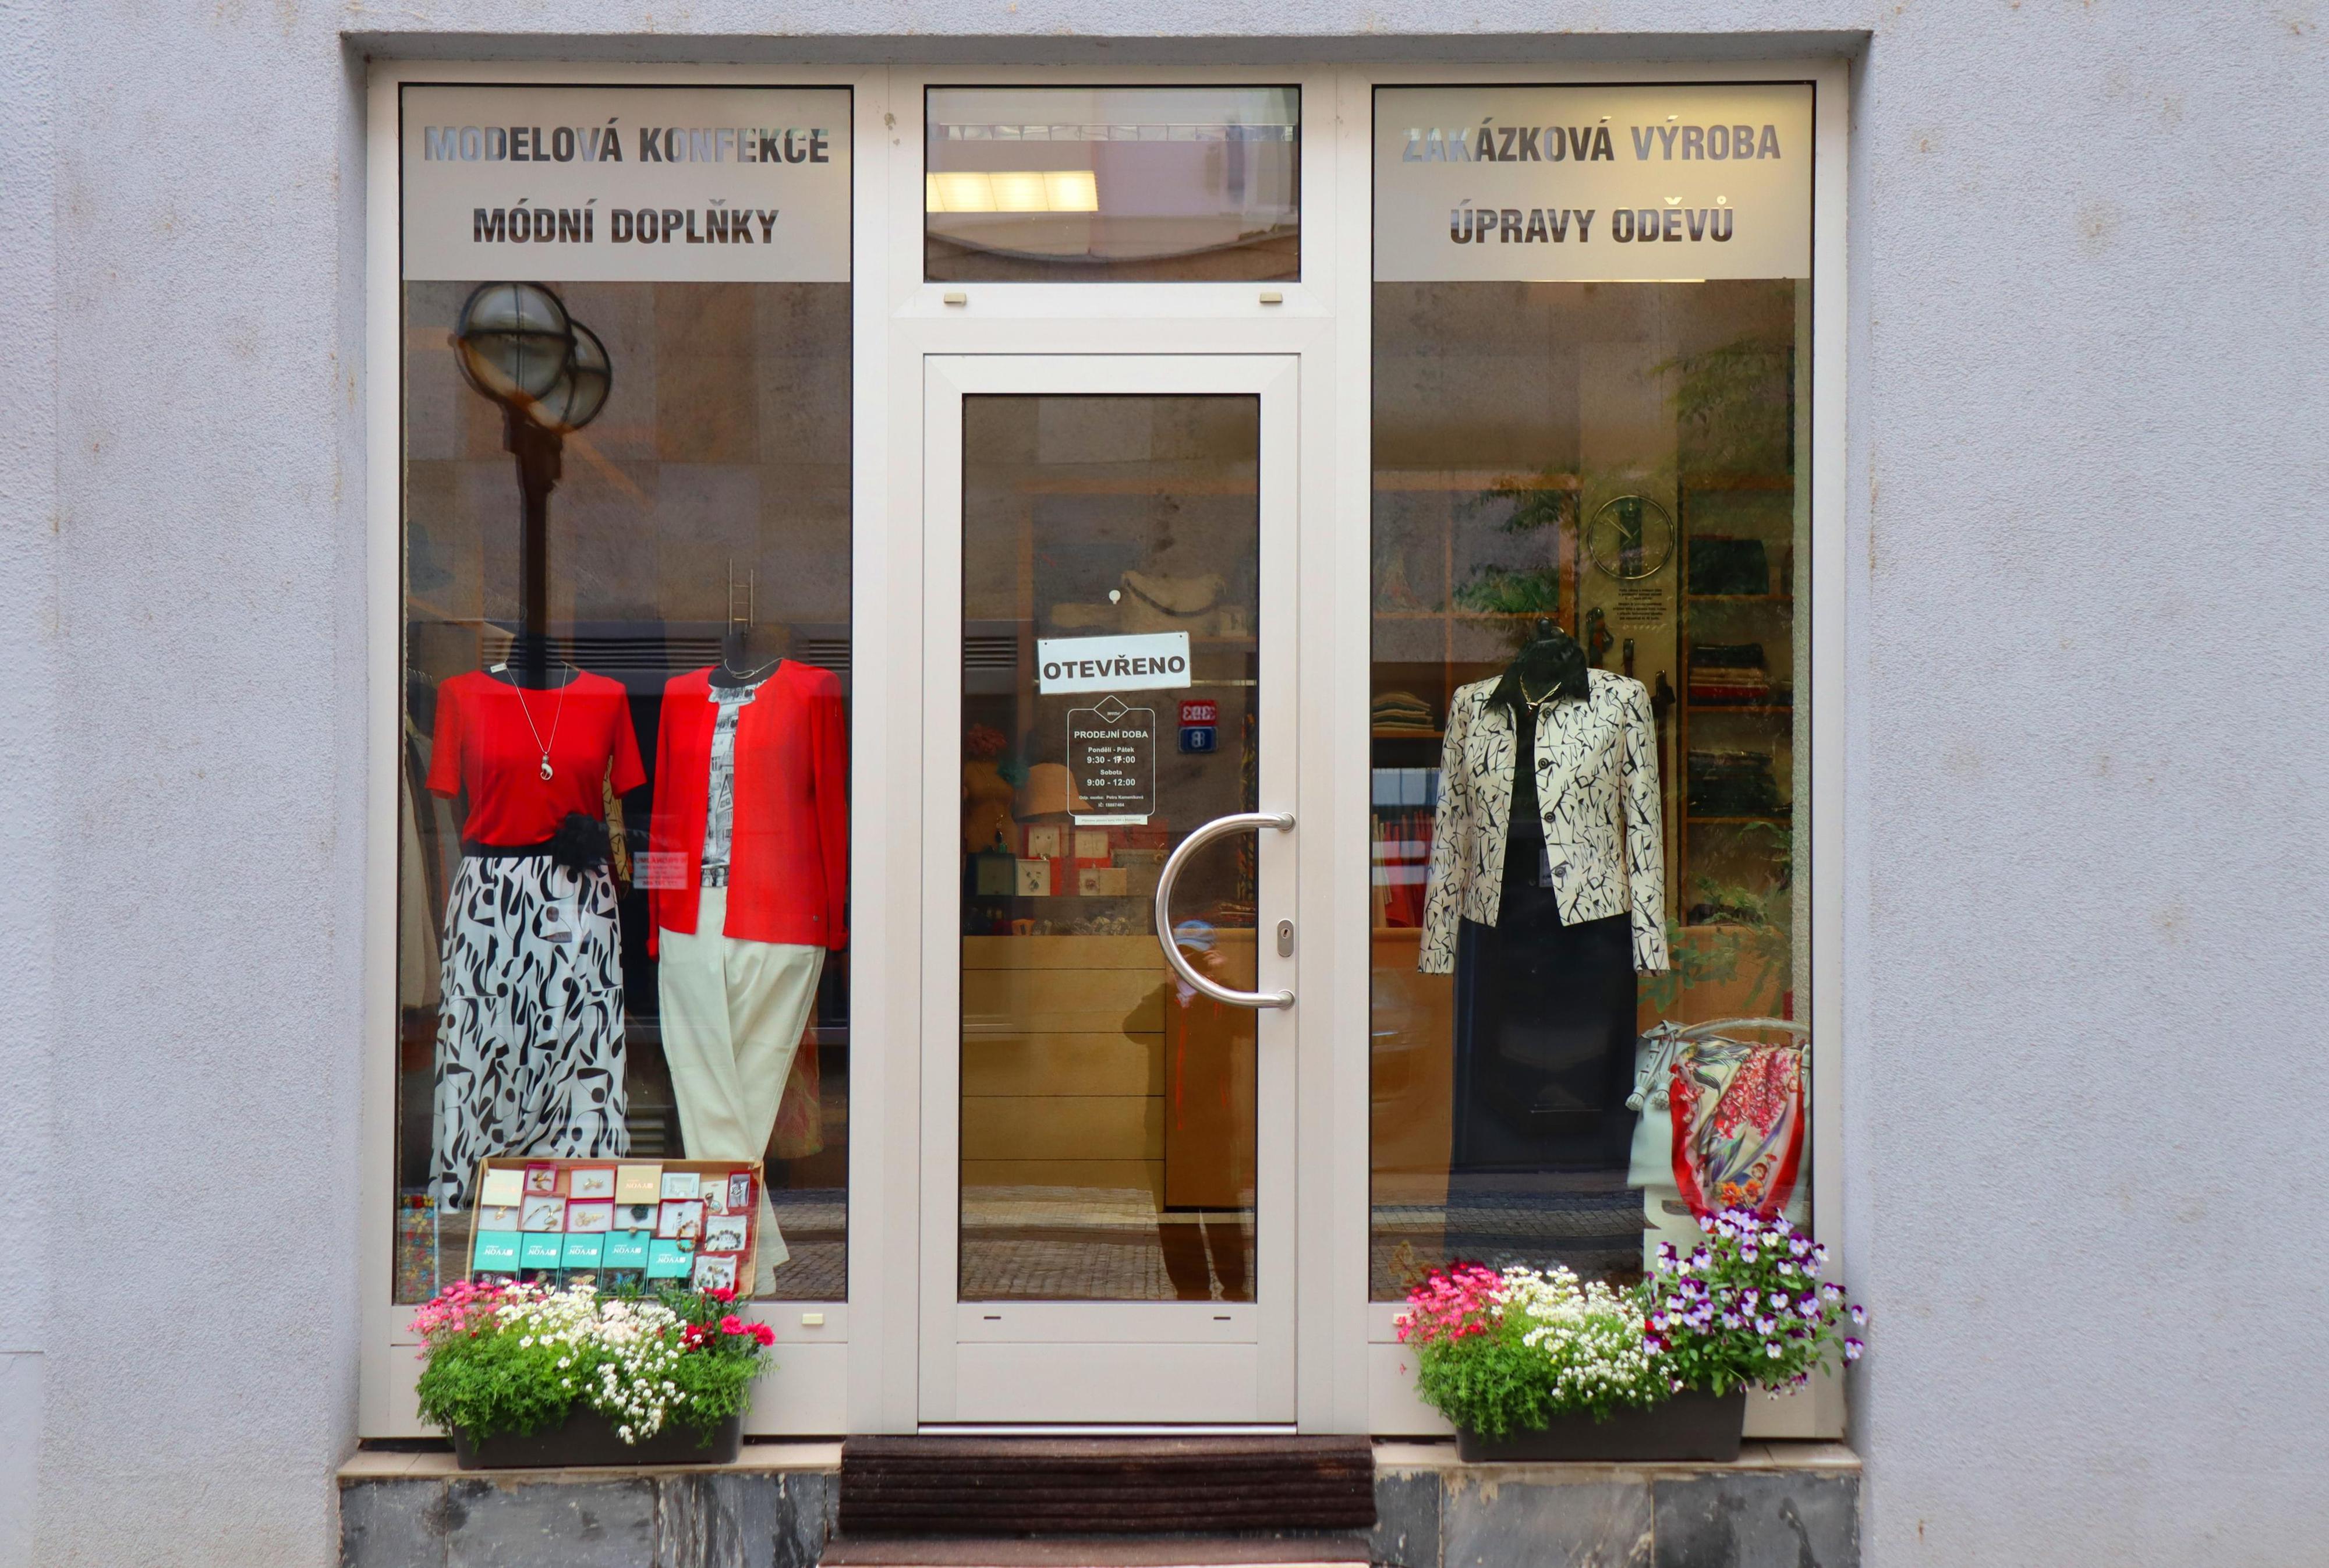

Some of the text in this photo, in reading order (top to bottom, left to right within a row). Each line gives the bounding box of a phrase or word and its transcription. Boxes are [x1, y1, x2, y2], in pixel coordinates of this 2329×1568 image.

[424, 118, 829, 163] MODELOVÁ KONFEKCE
[1403, 115, 1782, 162] ZAKÁZKOVÁ VÝROBA
[473, 199, 779, 244] MÓDNÍ DOPLŇKY
[1450, 196, 1734, 244] ÚPRAVY ODĚVŮ
[1043, 654, 1185, 680] OTEVŘENO
[1074, 730, 1120, 738] PRODEJNÍ
[1087, 756, 1105, 764] 9:30
[1113, 756, 1135, 764] 17:00
